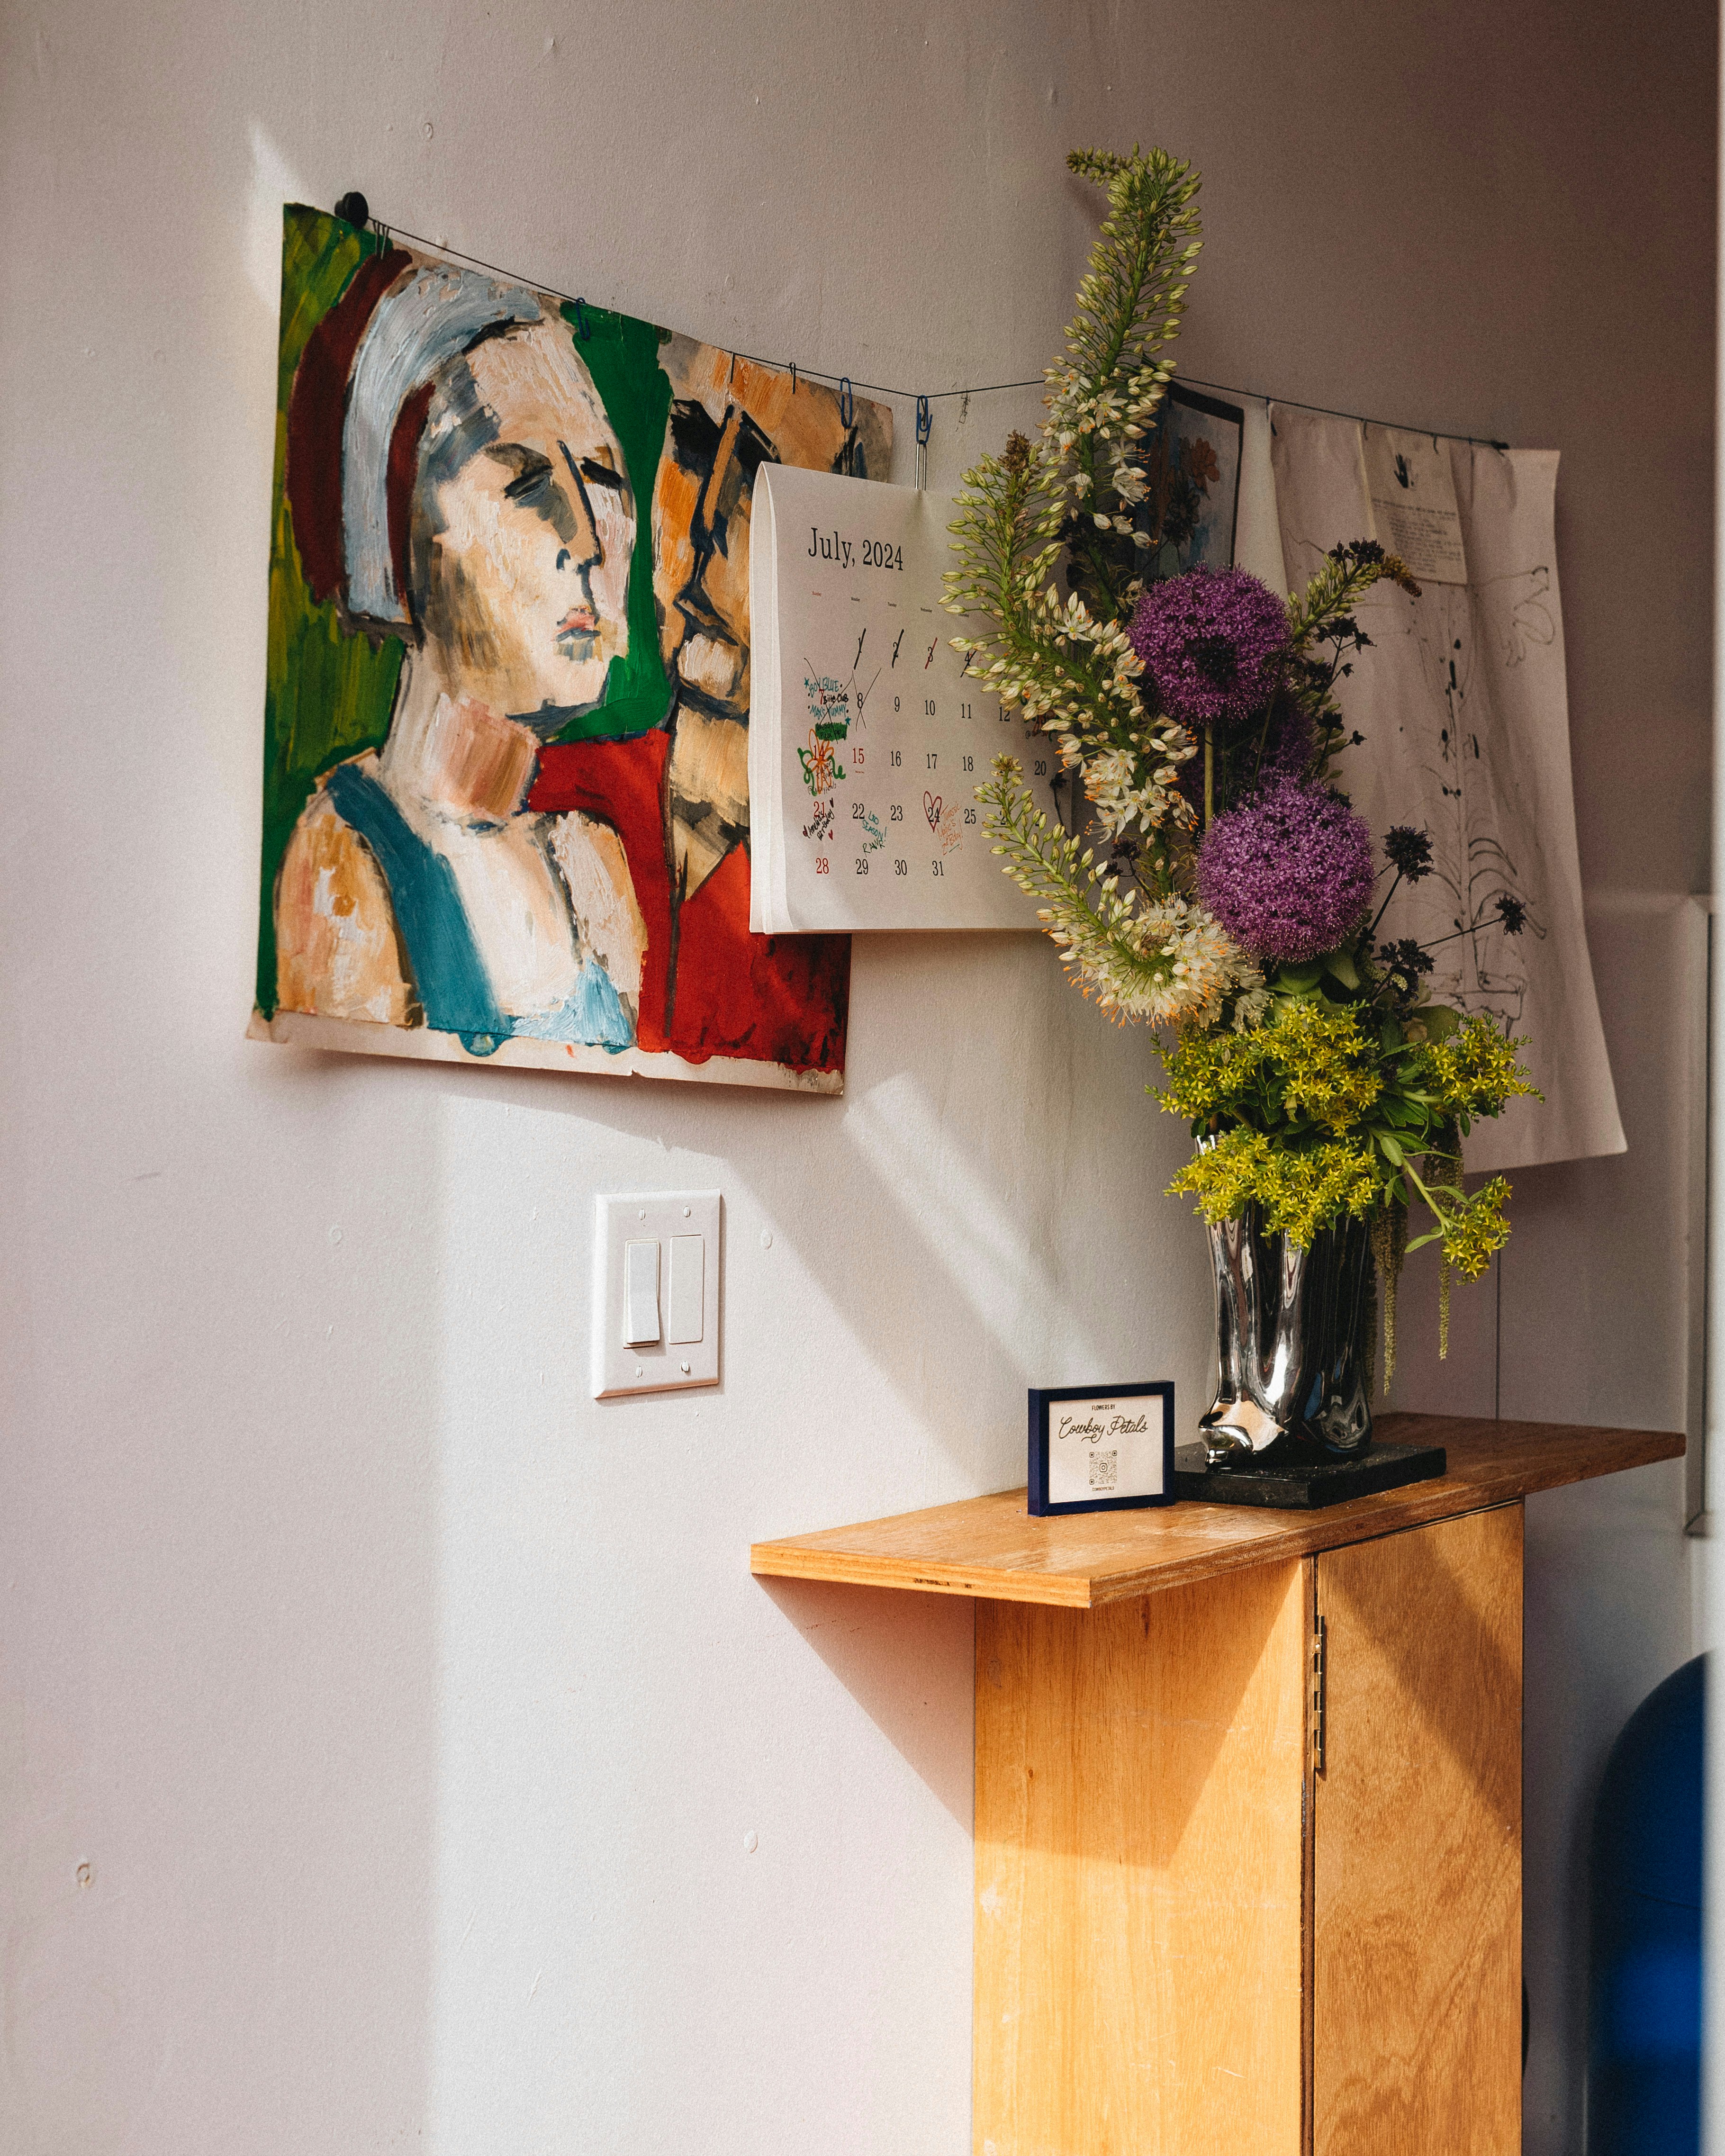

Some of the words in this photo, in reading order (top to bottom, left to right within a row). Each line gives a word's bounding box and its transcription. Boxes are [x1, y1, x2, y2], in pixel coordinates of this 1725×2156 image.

[808, 528, 855, 568] July,
[863, 540, 903, 570] 2024
[928, 647, 933, 662] 3
[964, 651, 971, 667] 4
[822, 677, 839, 693] BLUE
[819, 688, 825, 705] 7
[857, 693, 863, 709] 8
[894, 696, 900, 713] 9
[925, 700, 936, 716] 10
[961, 703, 972, 719] 11
[999, 706, 1010, 722] 12
[813, 745, 825, 761] 14
[853, 748, 865, 764] 15
[891, 750, 902, 767] 16
[926, 754, 938, 769] 17
[962, 756, 974, 772] 18
[1034, 760, 1047, 776] 20
[813, 801, 825, 818] 21
[852, 803, 865, 819] 22
[891, 805, 903, 821] 23
[928, 807, 940, 822] 24
[964, 808, 976, 824] 25
[815, 857, 829, 874] 28
[856, 858, 868, 875] 29
[894, 859, 907, 875] 30
[932, 860, 944, 876] 31
[1059, 1416, 1105, 1443] Cowboy
[1107, 1415, 1148, 1436] Petals
